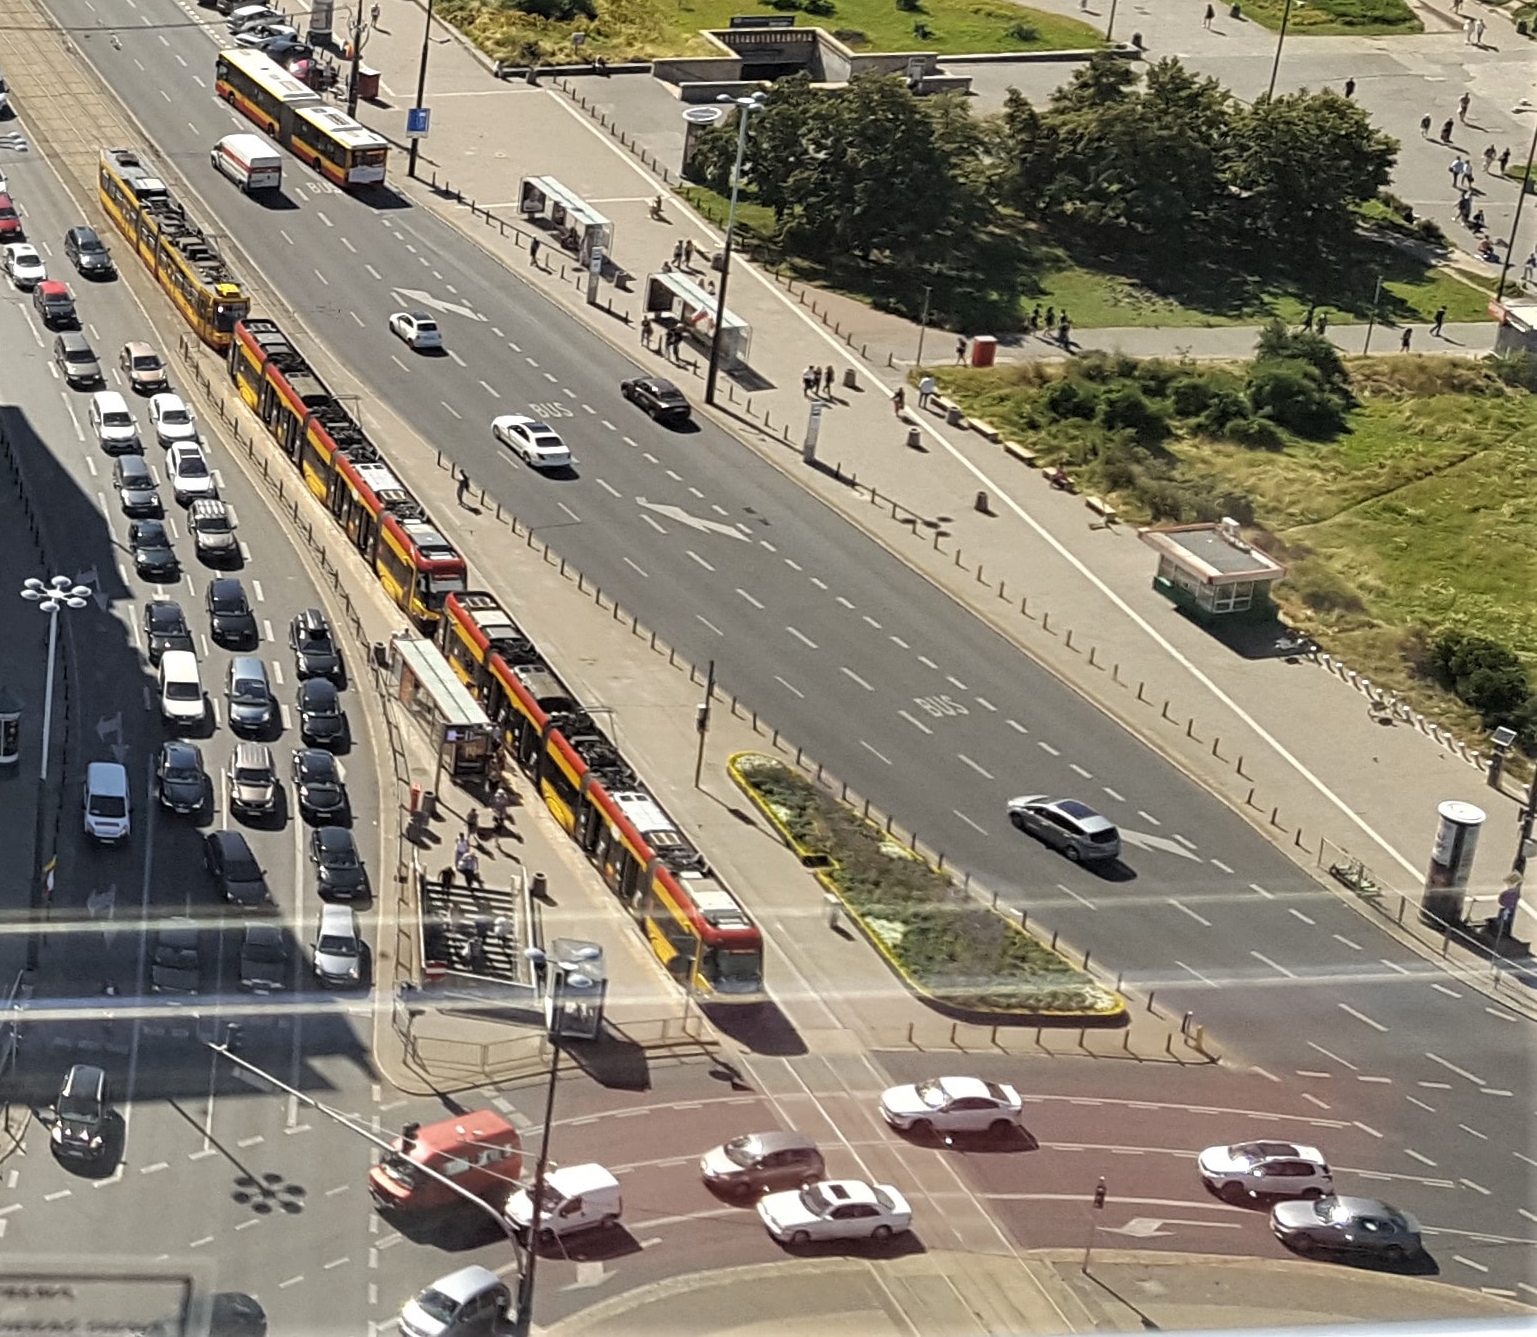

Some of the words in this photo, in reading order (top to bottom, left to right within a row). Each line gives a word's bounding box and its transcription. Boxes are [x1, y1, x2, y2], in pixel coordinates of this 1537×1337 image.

[306, 181, 343, 196] BUS
[529, 401, 574, 419] BUS
[913, 694, 969, 718] BUS
